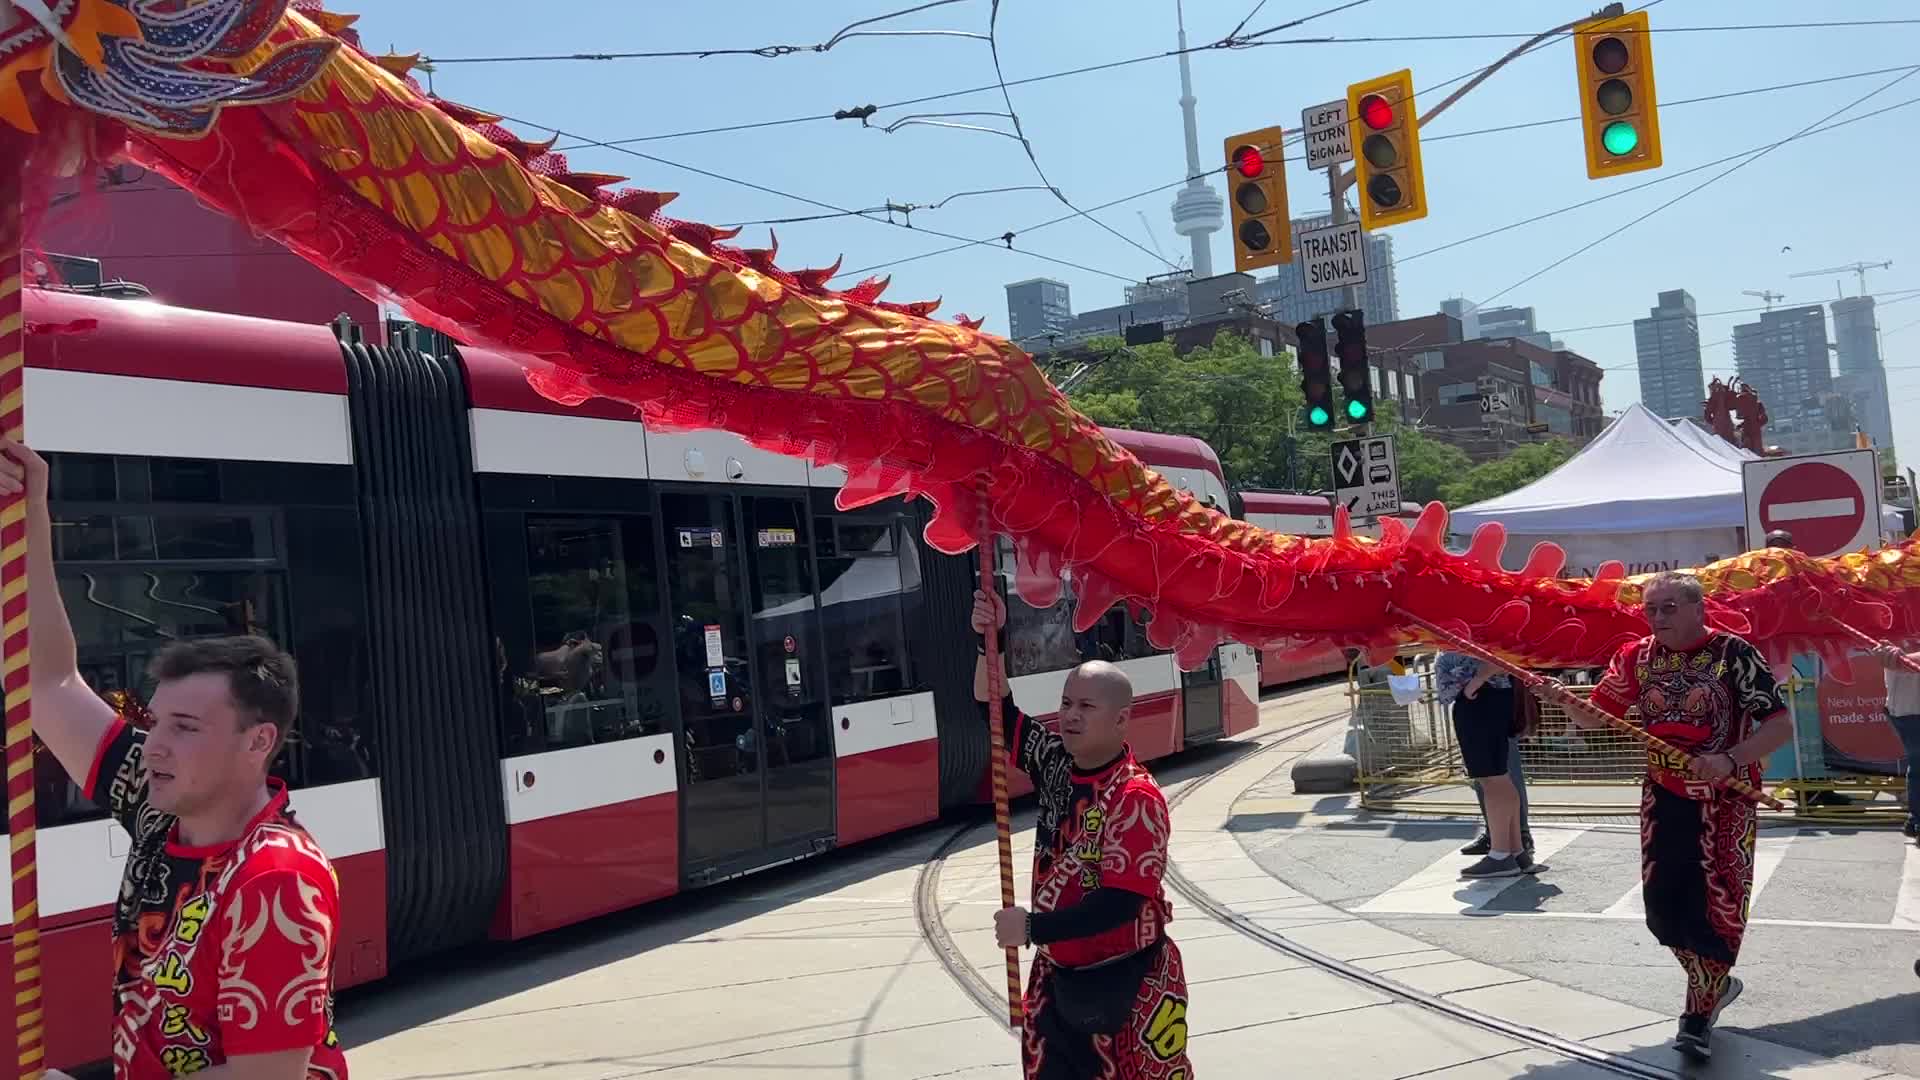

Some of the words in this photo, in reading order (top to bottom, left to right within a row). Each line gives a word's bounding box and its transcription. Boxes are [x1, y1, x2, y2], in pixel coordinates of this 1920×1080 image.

[1309, 109, 1342, 127] LEFT
[1311, 125, 1346, 144] TURN
[1310, 143, 1350, 161] SIGNAL
[1303, 230, 1358, 259] TRANSIT
[1311, 258, 1359, 284] SIGNAL
[1371, 489, 1396, 500] THIS
[1367, 501, 1397, 512] LANE
[1827, 696, 1853, 708] New
[1829, 711, 1865, 724] made
